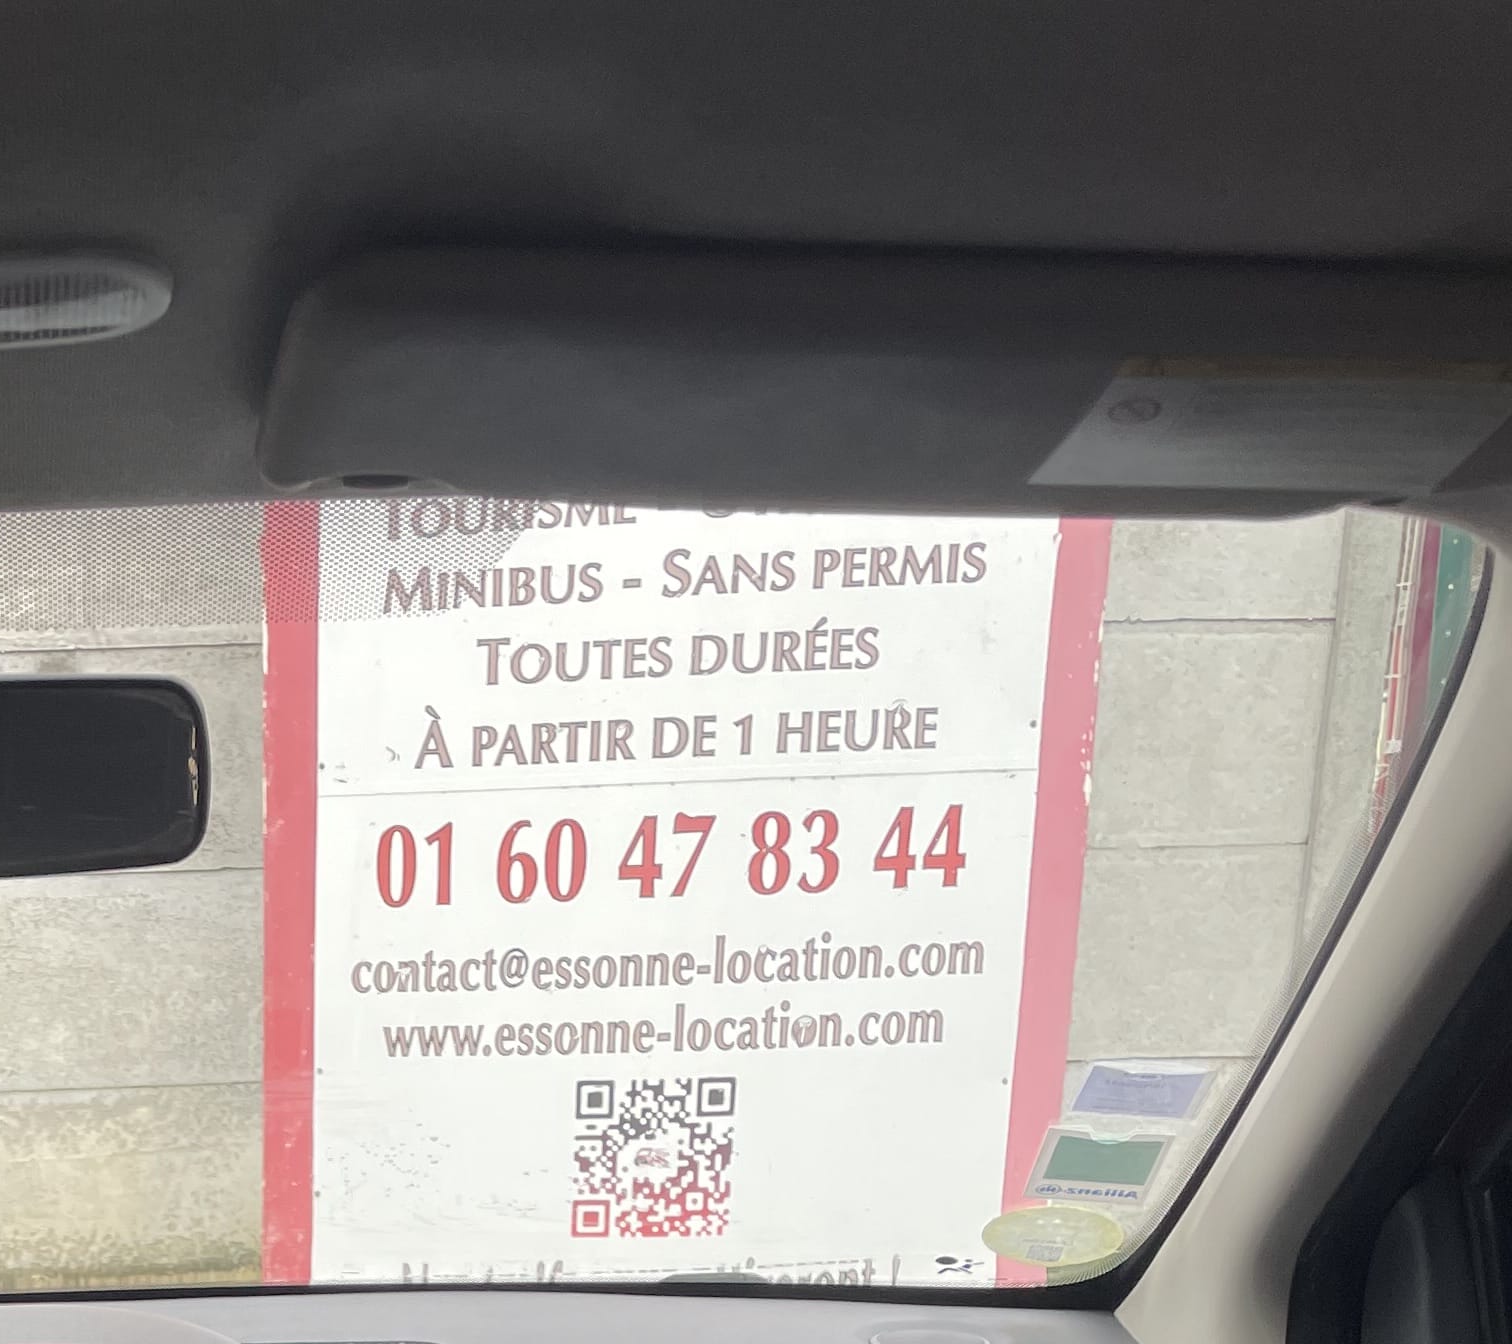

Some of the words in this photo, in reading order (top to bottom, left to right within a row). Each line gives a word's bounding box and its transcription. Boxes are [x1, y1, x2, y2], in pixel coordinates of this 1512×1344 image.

[382, 562, 604, 614] MINIBUS
[661, 548, 796, 598] SANS
[812, 541, 987, 590] PERMIS
[476, 635, 674, 686] TOUTES
[688, 616, 880, 676] DURÉES
[414, 704, 454, 769] À
[471, 718, 636, 767] PARTIR
[651, 715, 718, 759] DE
[733, 713, 754, 755] 1
[775, 706, 940, 754] HEURE
[376, 824, 454, 908] 01
[496, 818, 588, 904] 60
[617, 811, 717, 898] 47
[747, 809, 840, 895] 83
[873, 803, 967, 889] 44
[350, 930, 985, 994] contact@essonne-location.com
[383, 999, 944, 1058] www.essonne-location.com
